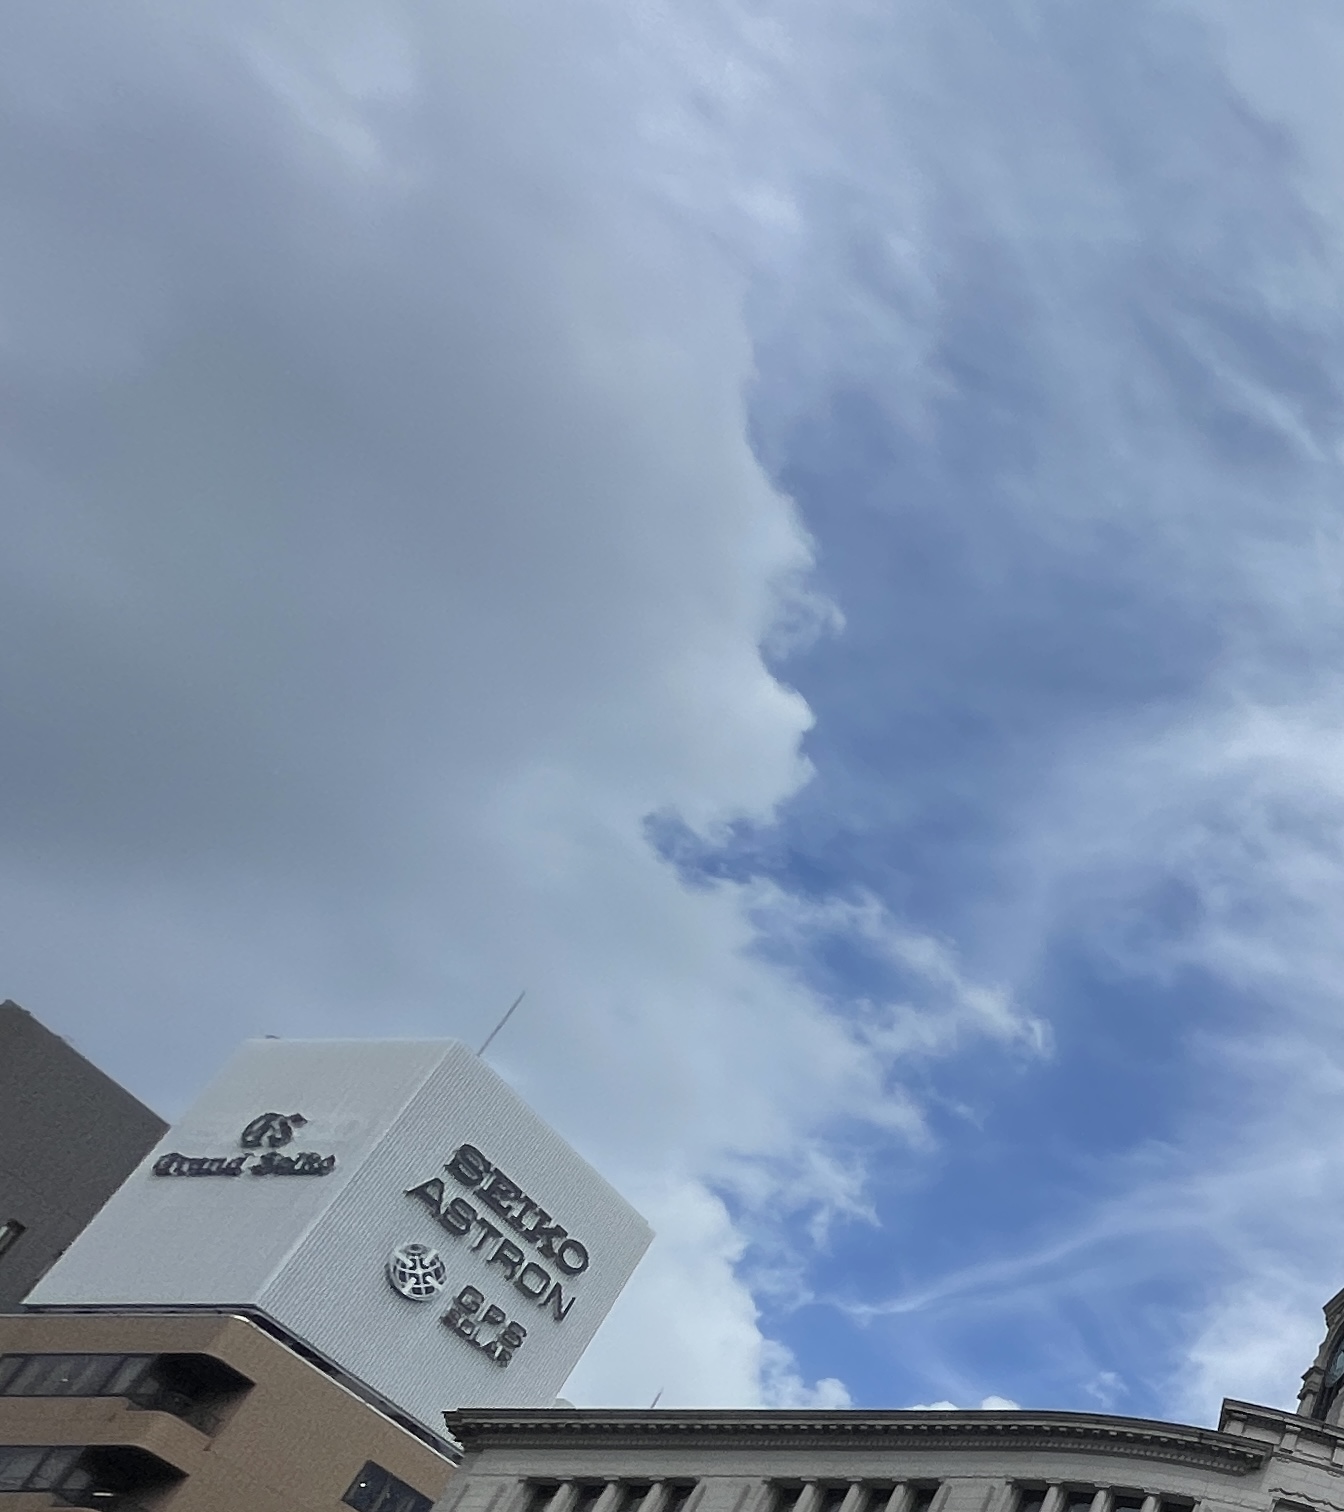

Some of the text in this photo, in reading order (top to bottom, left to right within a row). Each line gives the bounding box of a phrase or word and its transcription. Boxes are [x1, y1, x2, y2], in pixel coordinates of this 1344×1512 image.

[152, 1151, 336, 1177] Grand Seiko
[444, 1144, 590, 1275] SEIKO
[404, 1177, 576, 1322] ASTRON
[440, 1312, 514, 1368] SOLAR
[458, 1286, 528, 1349] GPS
